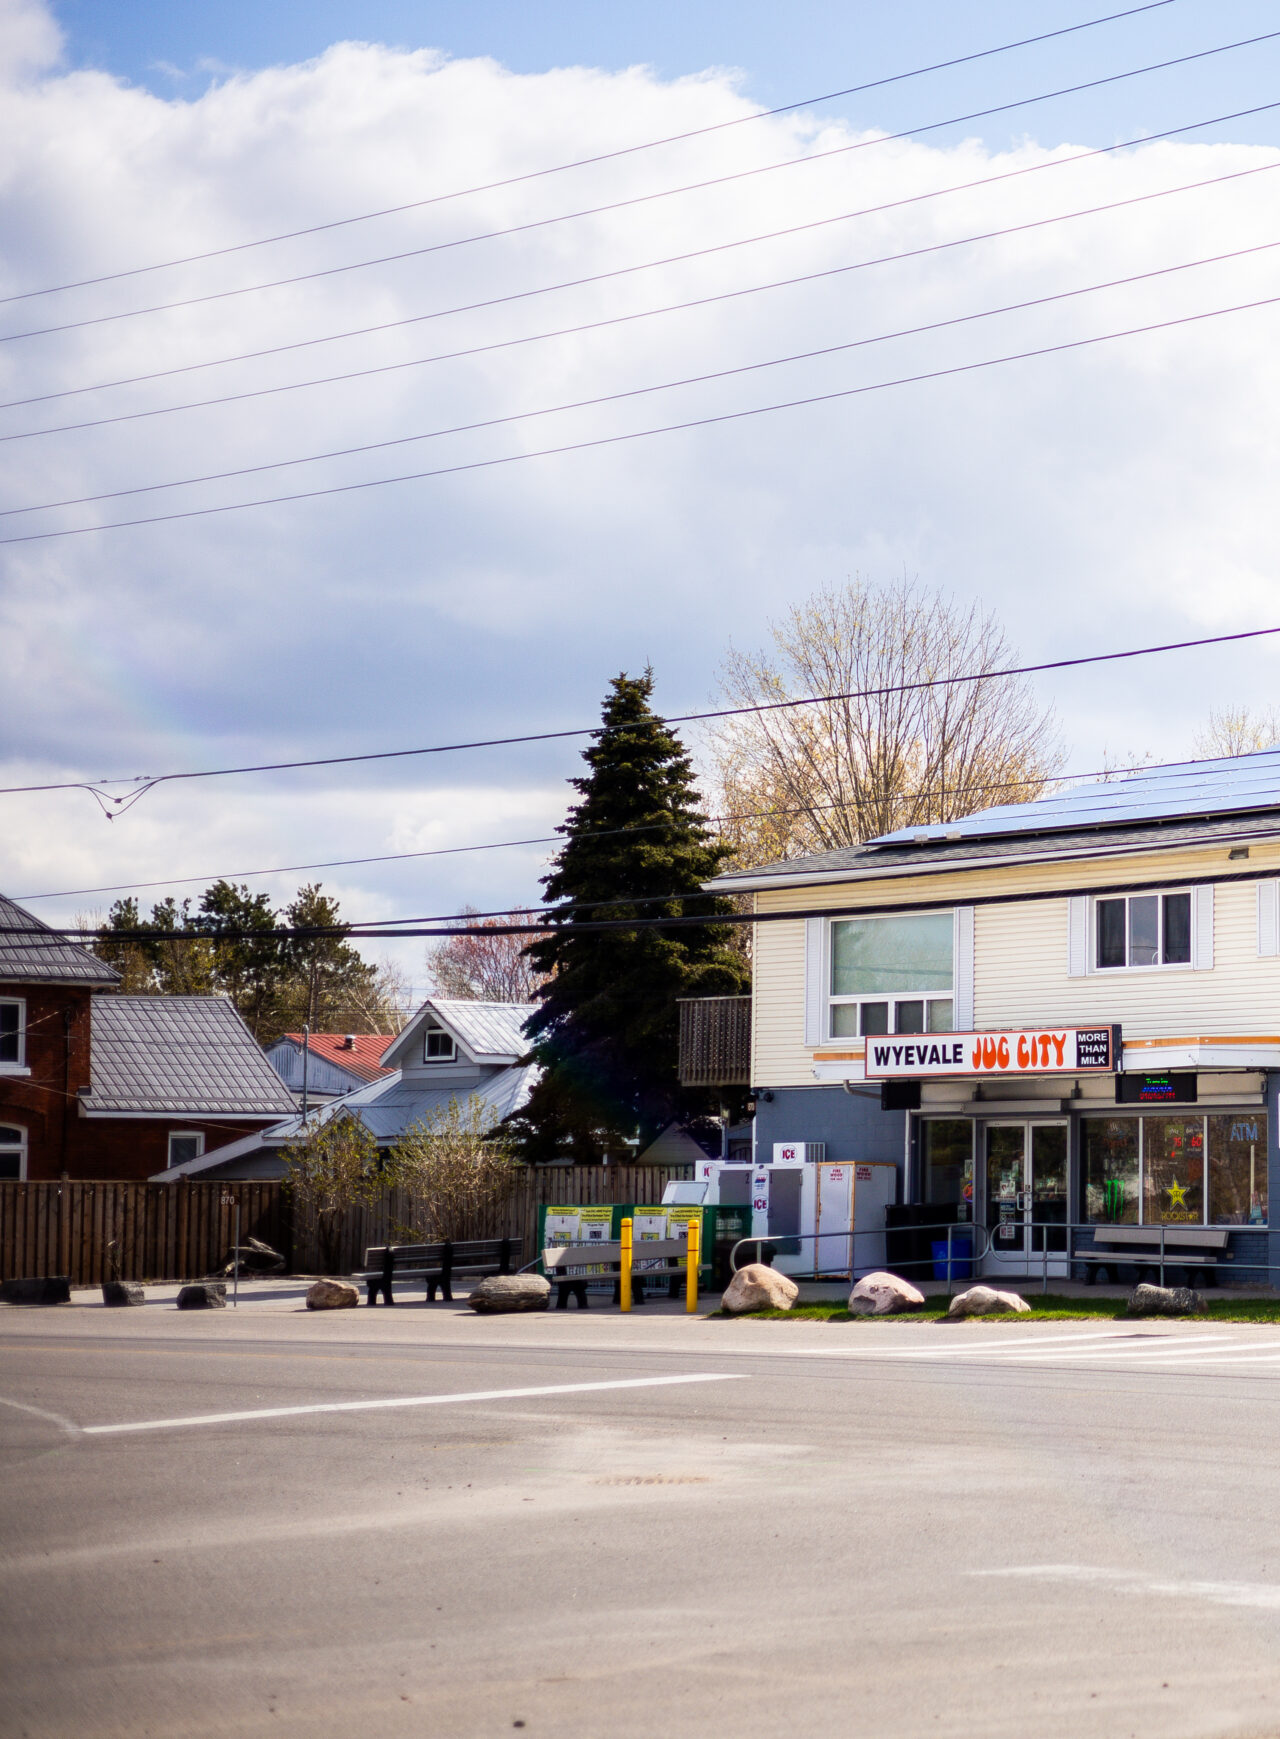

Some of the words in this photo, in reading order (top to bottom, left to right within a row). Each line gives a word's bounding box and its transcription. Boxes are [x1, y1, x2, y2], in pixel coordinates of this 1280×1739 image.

[1077, 1032, 1108, 1043] MORE
[873, 1043, 964, 1067] WYEVALE
[971, 1036, 1010, 1070] JUG
[1016, 1033, 1067, 1069] CITY
[1079, 1044, 1107, 1054] THAN
[1080, 1055, 1106, 1065] MILK
[1230, 1123, 1259, 1141] ATM
[782, 1149, 796, 1160] ICE
[220, 1196, 235, 1205] 870
[753, 1199, 767, 1210] ICE
